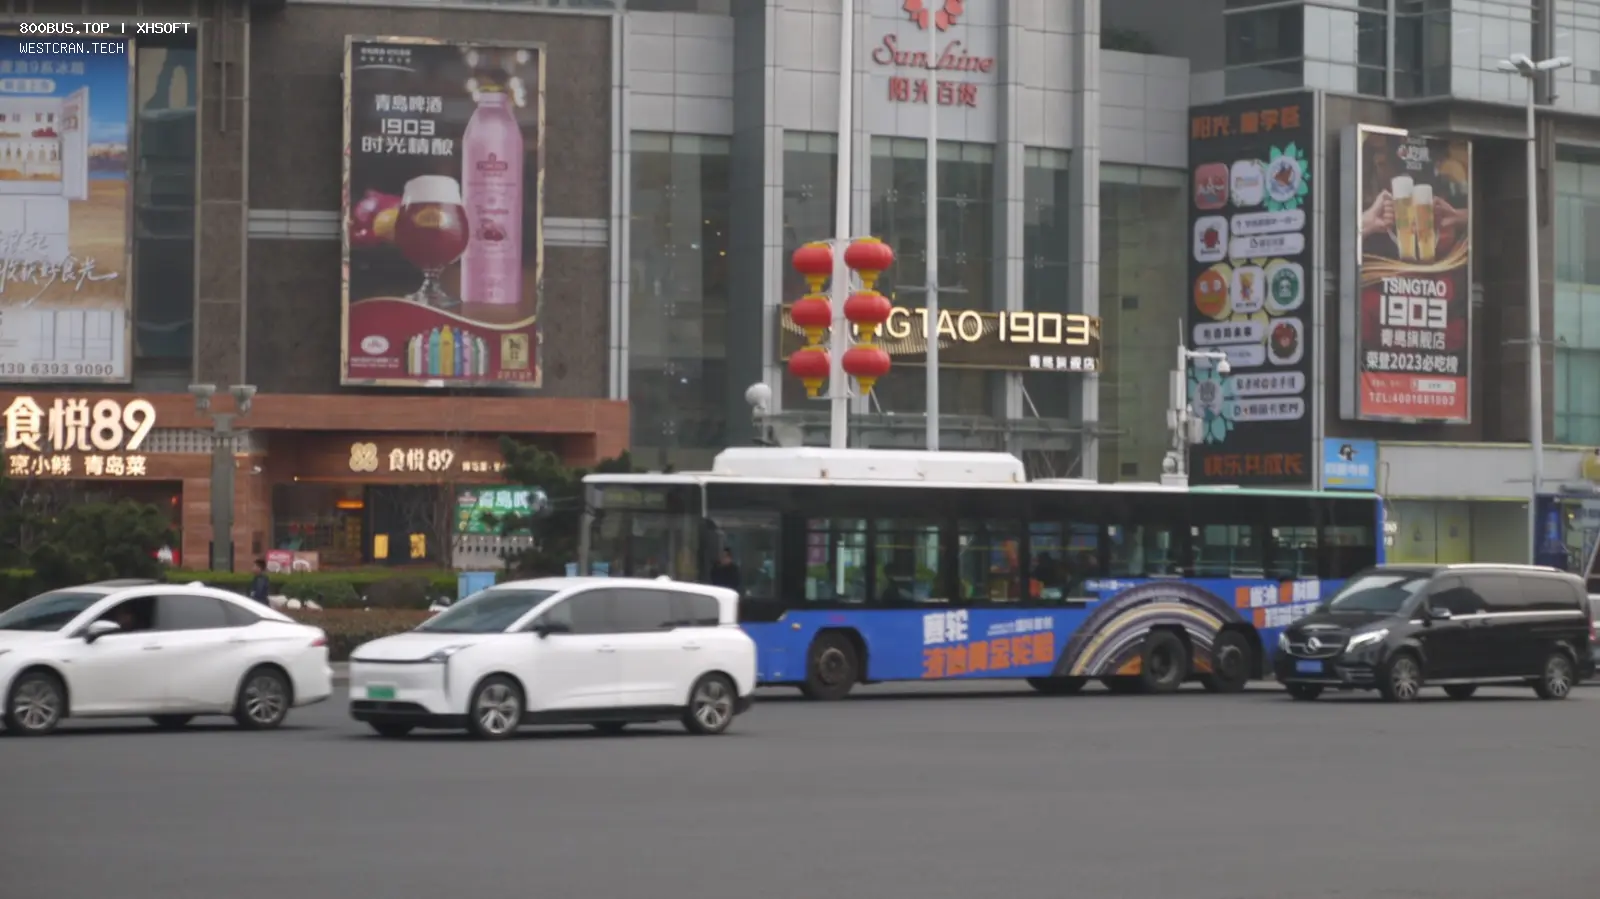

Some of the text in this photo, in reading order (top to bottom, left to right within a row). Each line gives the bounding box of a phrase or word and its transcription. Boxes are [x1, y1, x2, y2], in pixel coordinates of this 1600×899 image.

[872, 33, 995, 73] Sunhine
[375, 93, 443, 113] 青岛啤酒
[381, 118, 436, 136] 1903
[361, 135, 454, 156] 时光精酿
[1381, 276, 1447, 297] TSINGTAO
[1380, 295, 1448, 328] 1903
[999, 309, 1090, 345] 1903
[1381, 329, 1446, 350] 青岛旗舰店
[1366, 351, 1459, 373] 荣登2023必吃榜
[3, 396, 157, 451] 食悦89
[10, 454, 148, 476] 烹小鲜 青岛菜
[388, 447, 456, 472] 食悦89
[479, 490, 548, 510] 青岛啤
